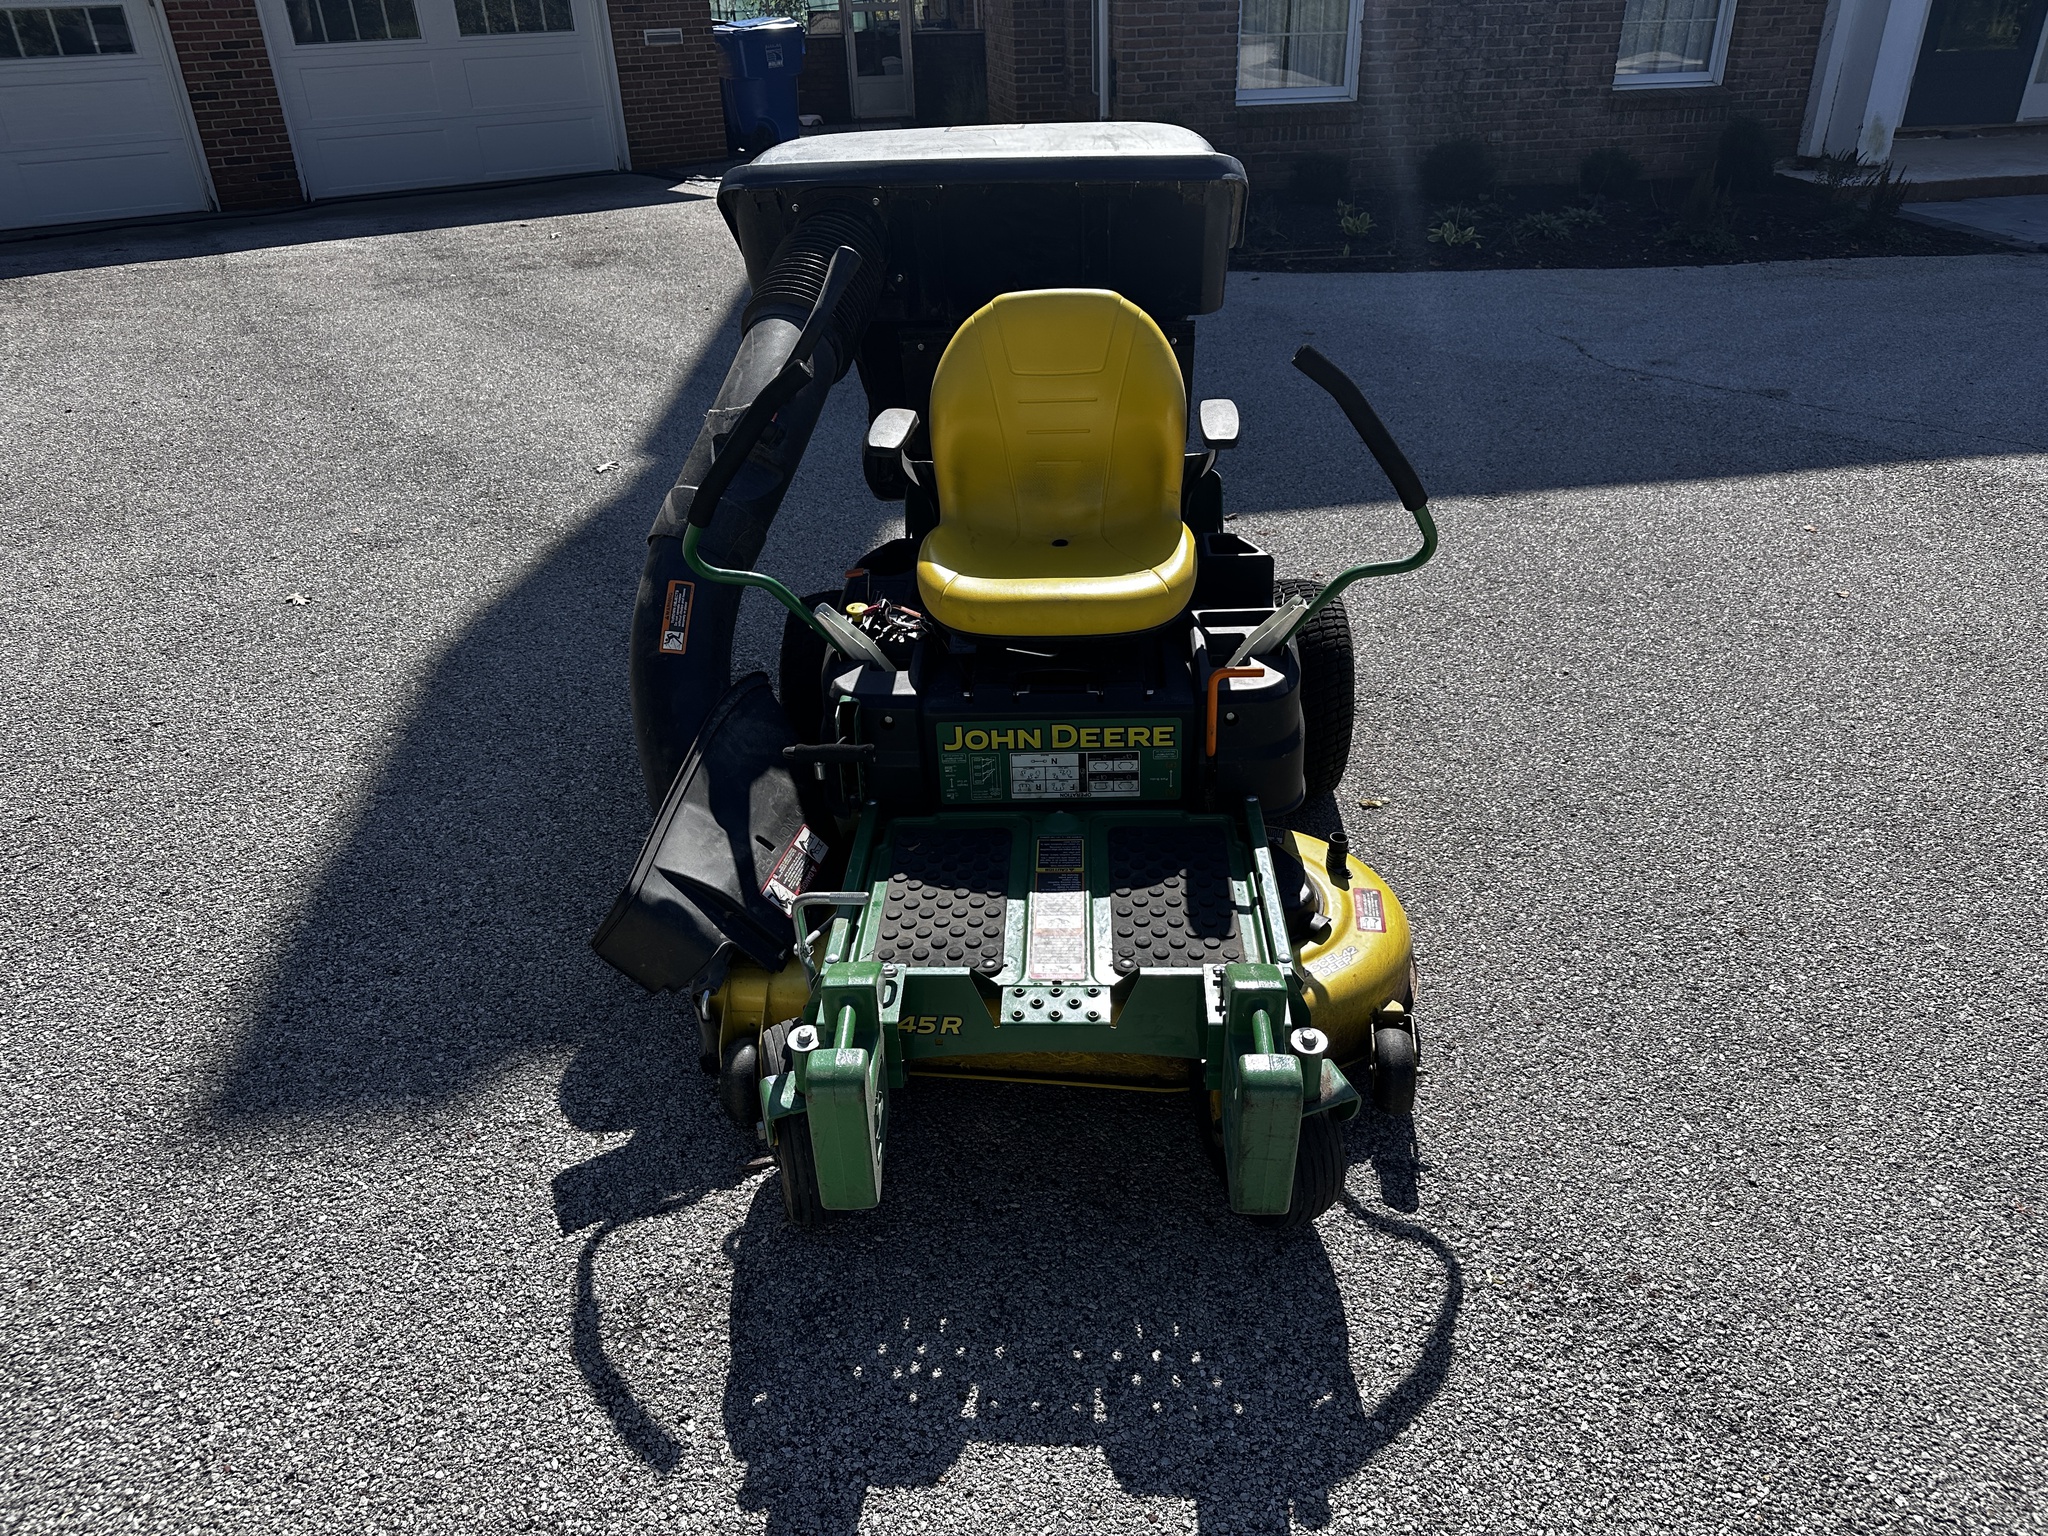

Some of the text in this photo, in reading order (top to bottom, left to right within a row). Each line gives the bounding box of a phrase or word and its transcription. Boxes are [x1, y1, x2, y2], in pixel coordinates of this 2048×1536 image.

[943, 724, 1175, 751] JOHN DEERE
[1320, 956, 1352, 977] DEEP
